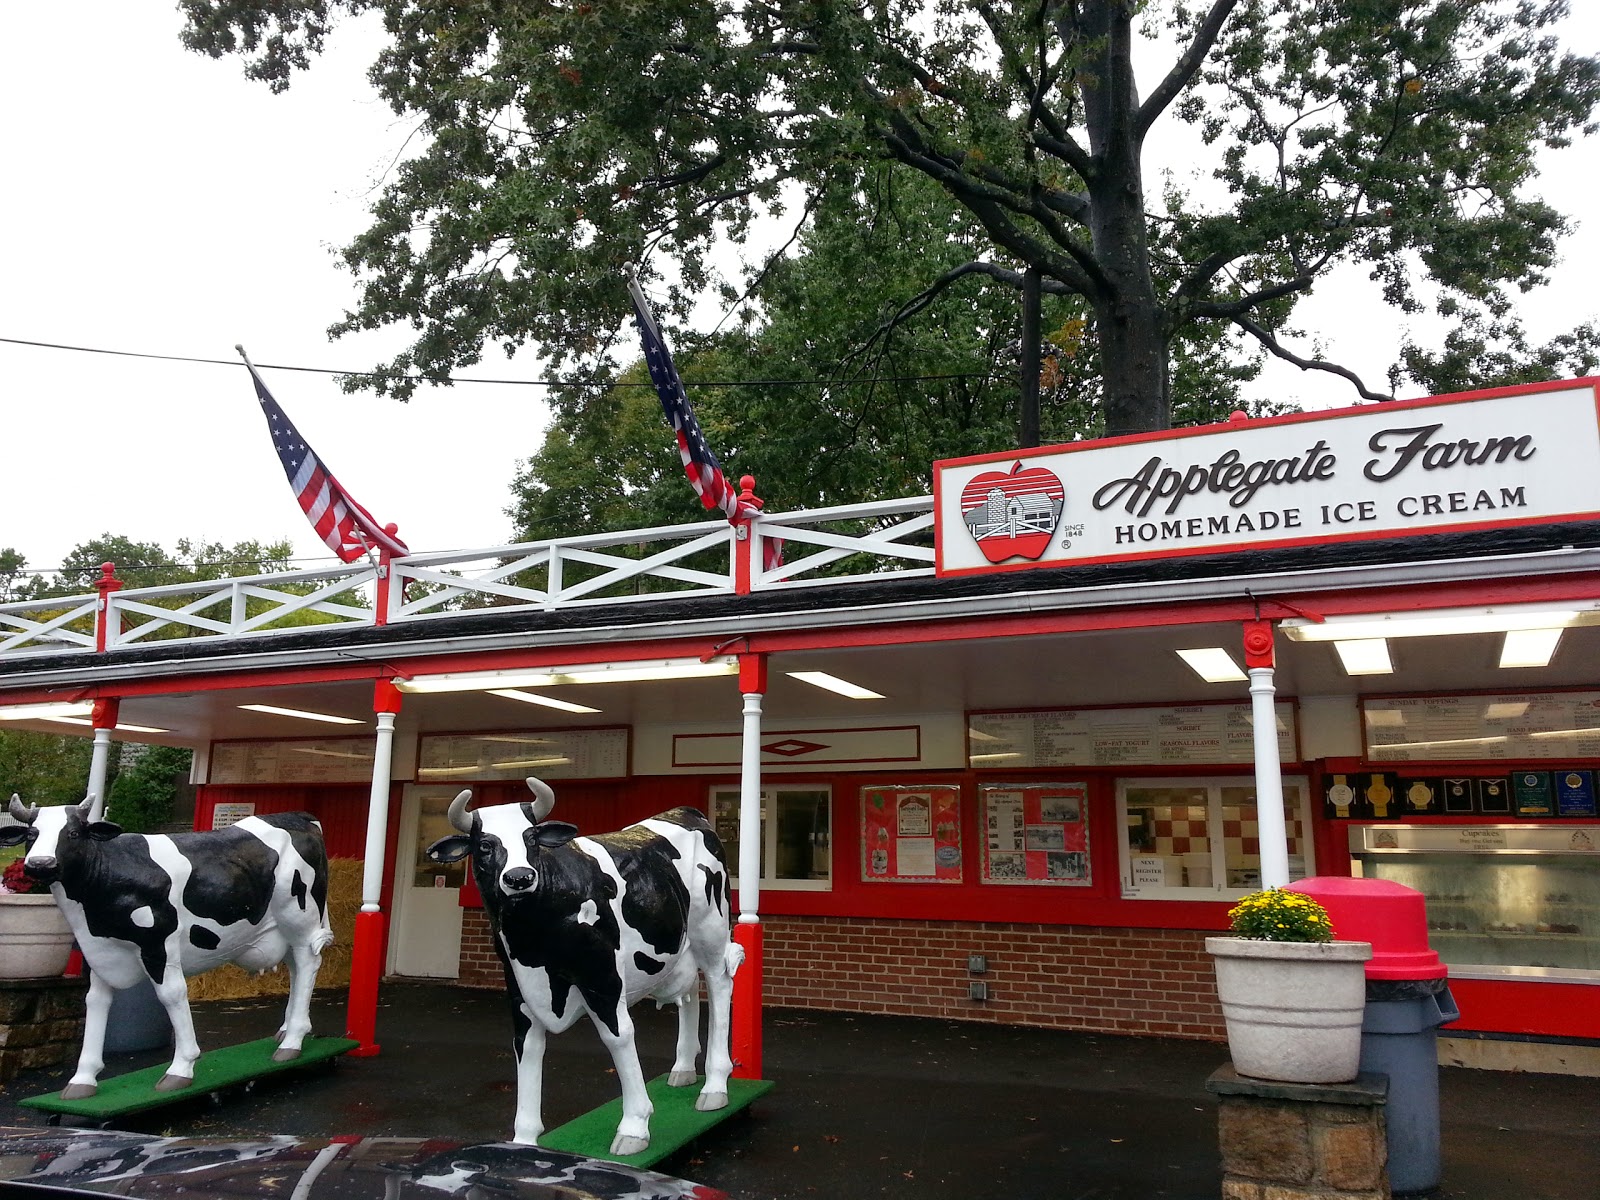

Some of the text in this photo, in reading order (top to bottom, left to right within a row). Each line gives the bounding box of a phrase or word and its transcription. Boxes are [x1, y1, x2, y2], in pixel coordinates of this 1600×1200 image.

[1092, 423, 1537, 518] Applegate Farm
[1115, 486, 1528, 545] HOMEMADE ICE CREAM
[1064, 523, 1085, 532] SINCE
[1065, 530, 1083, 538] 1848
[1461, 830, 1500, 838] Cupcakes
